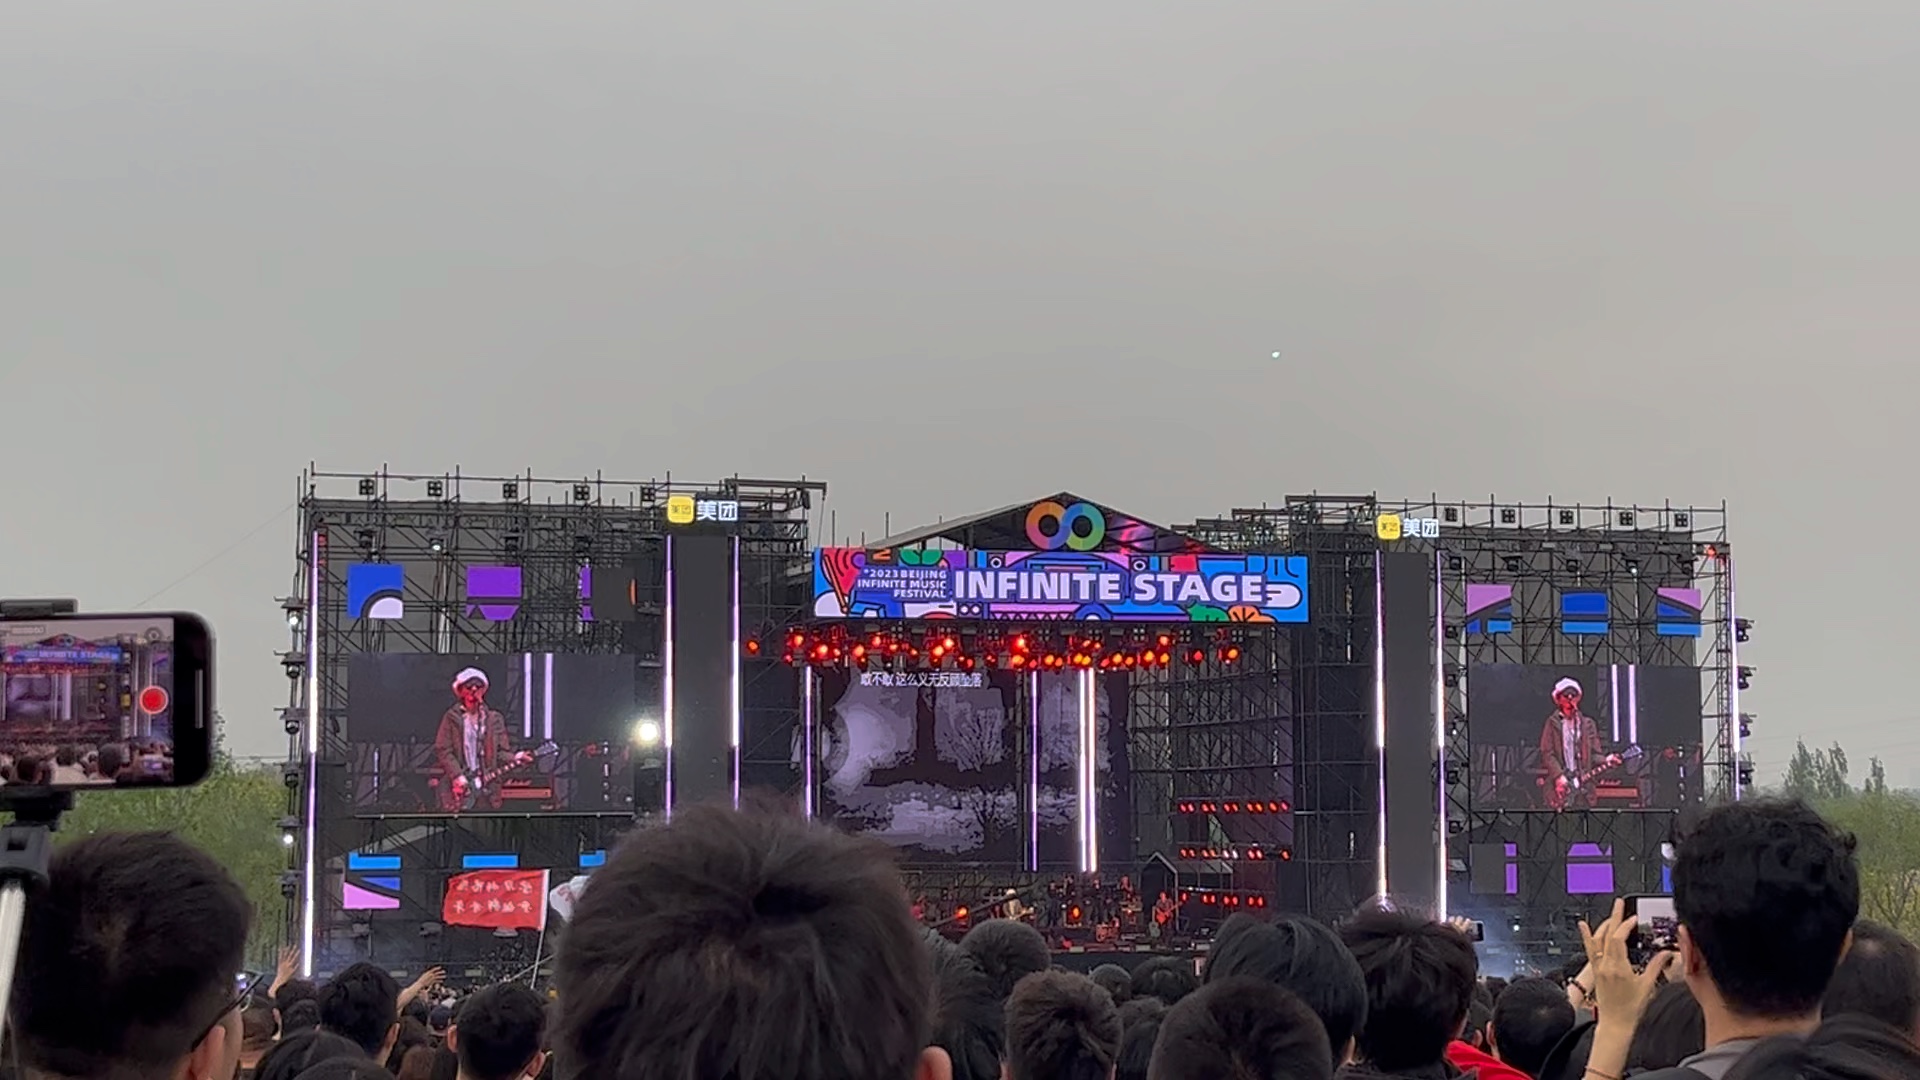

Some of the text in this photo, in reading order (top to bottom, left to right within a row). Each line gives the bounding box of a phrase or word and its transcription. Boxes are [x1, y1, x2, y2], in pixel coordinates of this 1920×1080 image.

[697, 500, 738, 521] 美团
[1403, 518, 1439, 538] 美团
[900, 569, 947, 579] BEIJING
[857, 579, 947, 589] INFINITE MUSIC
[955, 571, 1263, 602] INFINITE STAGE
[893, 589, 947, 598] FESTIVAL
